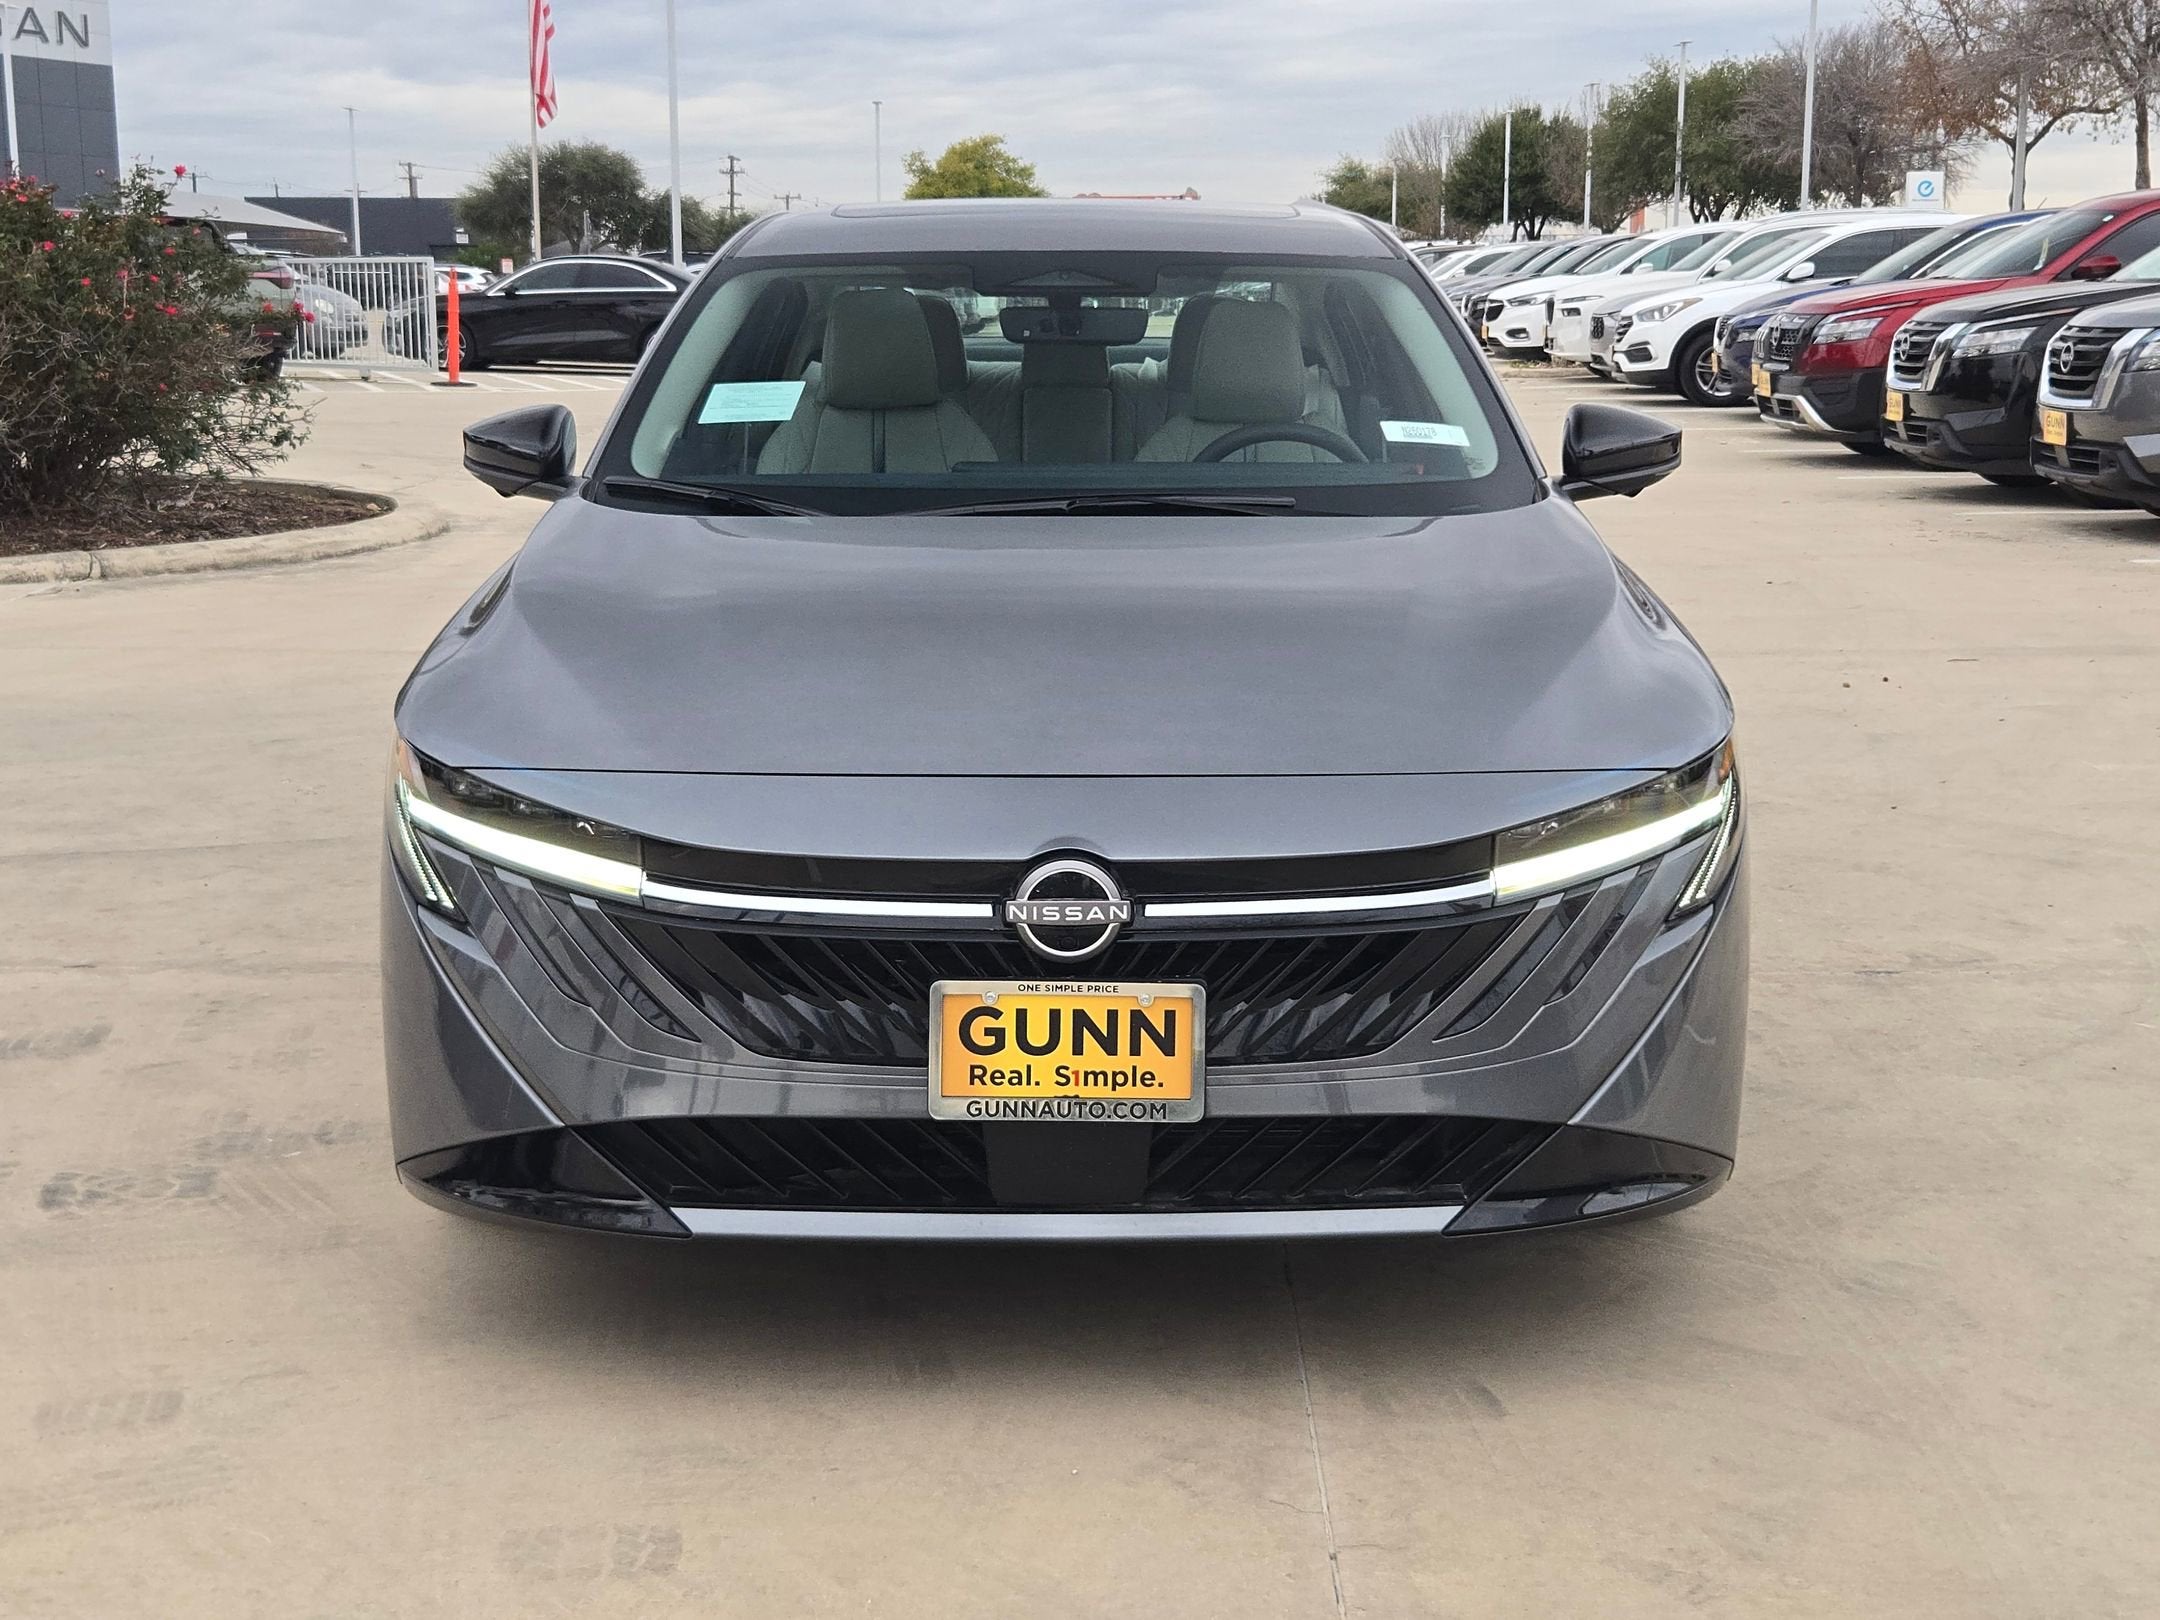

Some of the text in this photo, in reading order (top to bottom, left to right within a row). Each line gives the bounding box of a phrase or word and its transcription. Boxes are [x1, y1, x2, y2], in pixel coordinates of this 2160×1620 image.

[0, 7, 89, 48] AN
[2046, 415, 2065, 430] GUNN
[1009, 904, 1128, 921] NISSAN
[1017, 984, 1119, 993] ONE SIMPLE PRICE
[958, 1006, 1177, 1057] GUNN
[969, 1064, 1041, 1086] Real.
[966, 1099, 1168, 1120] GUNNAUTO.COM
